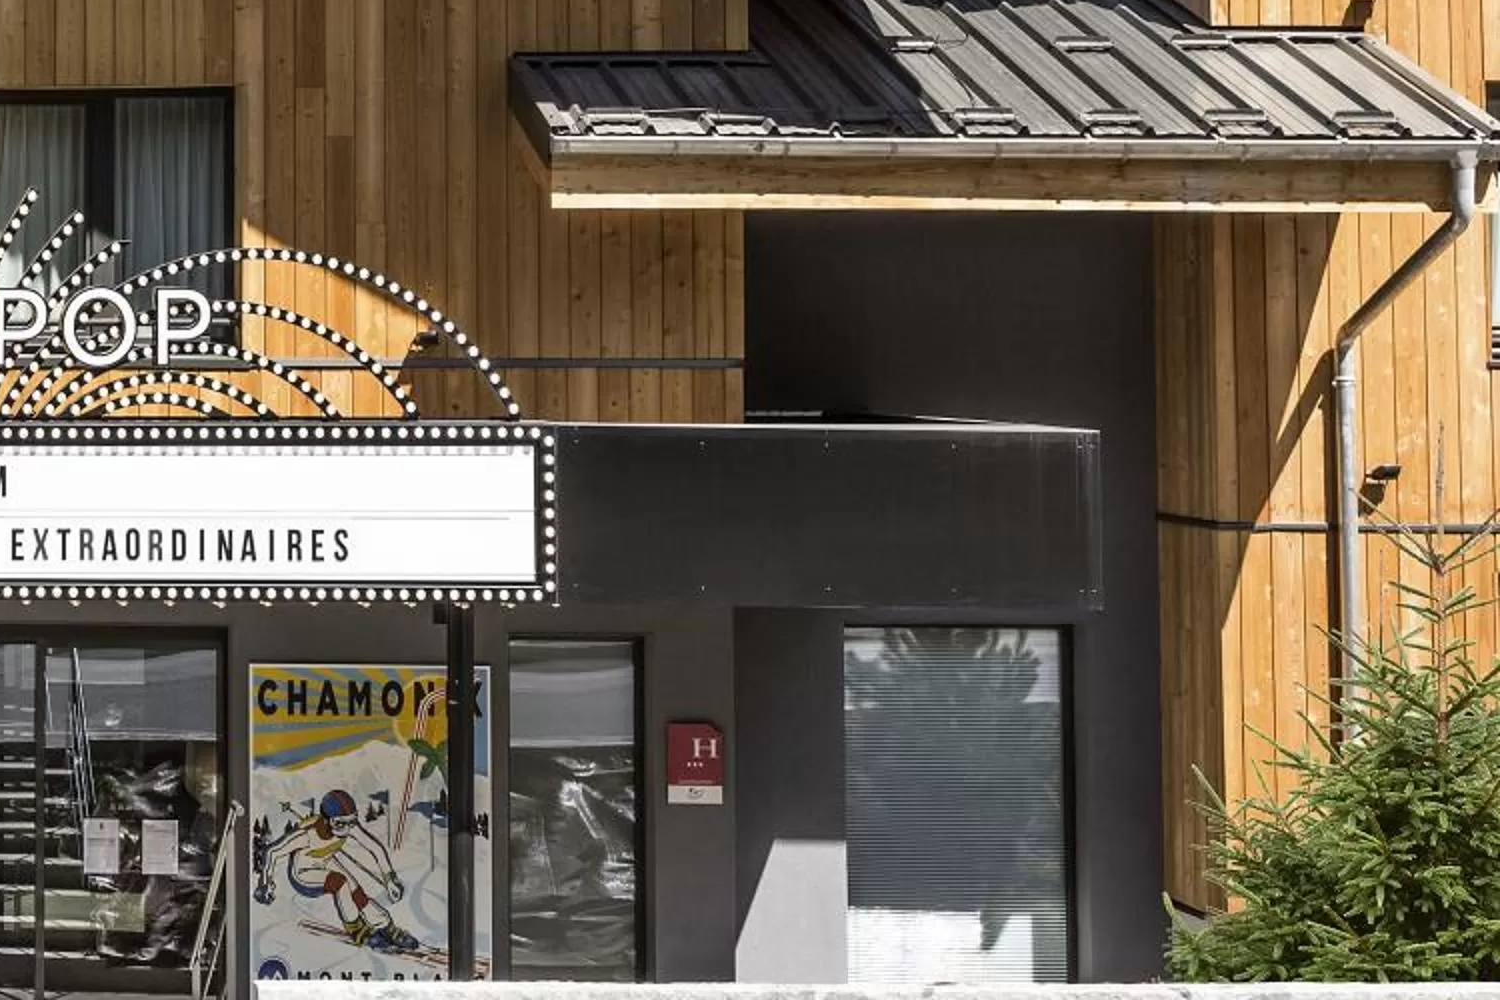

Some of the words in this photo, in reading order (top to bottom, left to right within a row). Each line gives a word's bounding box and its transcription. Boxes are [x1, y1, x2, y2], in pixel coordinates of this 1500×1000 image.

[10, 527, 351, 563] EXTRAORDINAIRES
[257, 679, 483, 717] CHAMONX
[692, 737, 719, 759] H
